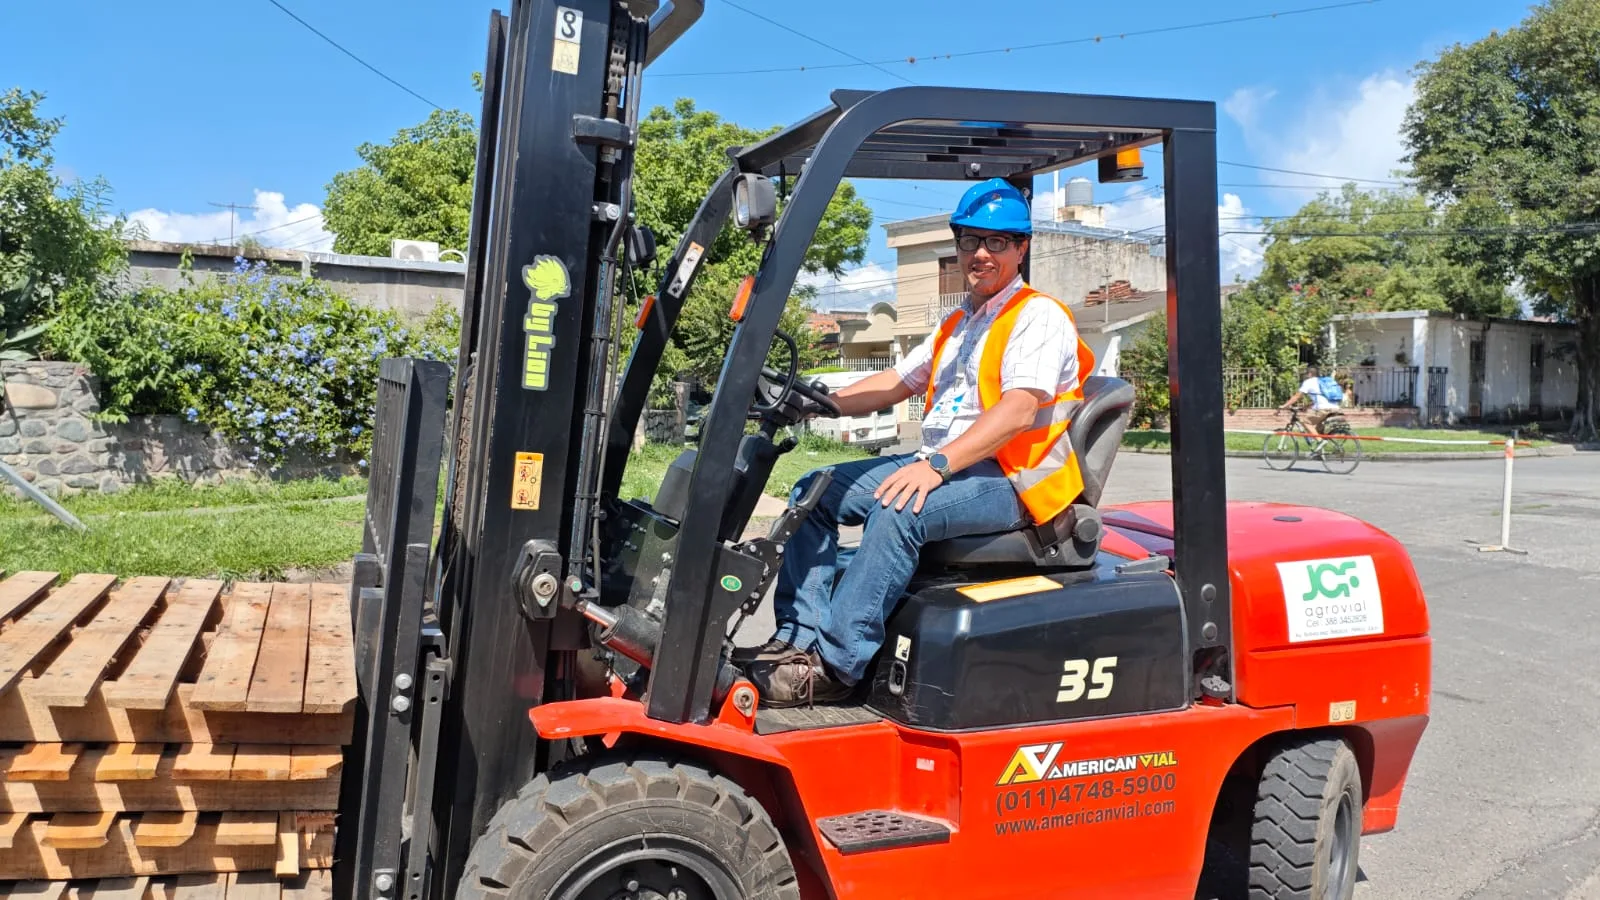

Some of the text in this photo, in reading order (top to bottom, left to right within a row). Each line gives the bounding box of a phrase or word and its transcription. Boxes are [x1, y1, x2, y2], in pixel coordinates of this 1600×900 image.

[524, 301, 555, 388] by Lion
[1304, 601, 1366, 618] agrovial
[1056, 656, 1118, 703] 35
[1047, 756, 1136, 779] AMERICAN
[1139, 751, 1177, 769] VIAL
[996, 773, 1176, 816] (011)4748-5900
[995, 800, 1175, 835] www.americanvial.com
